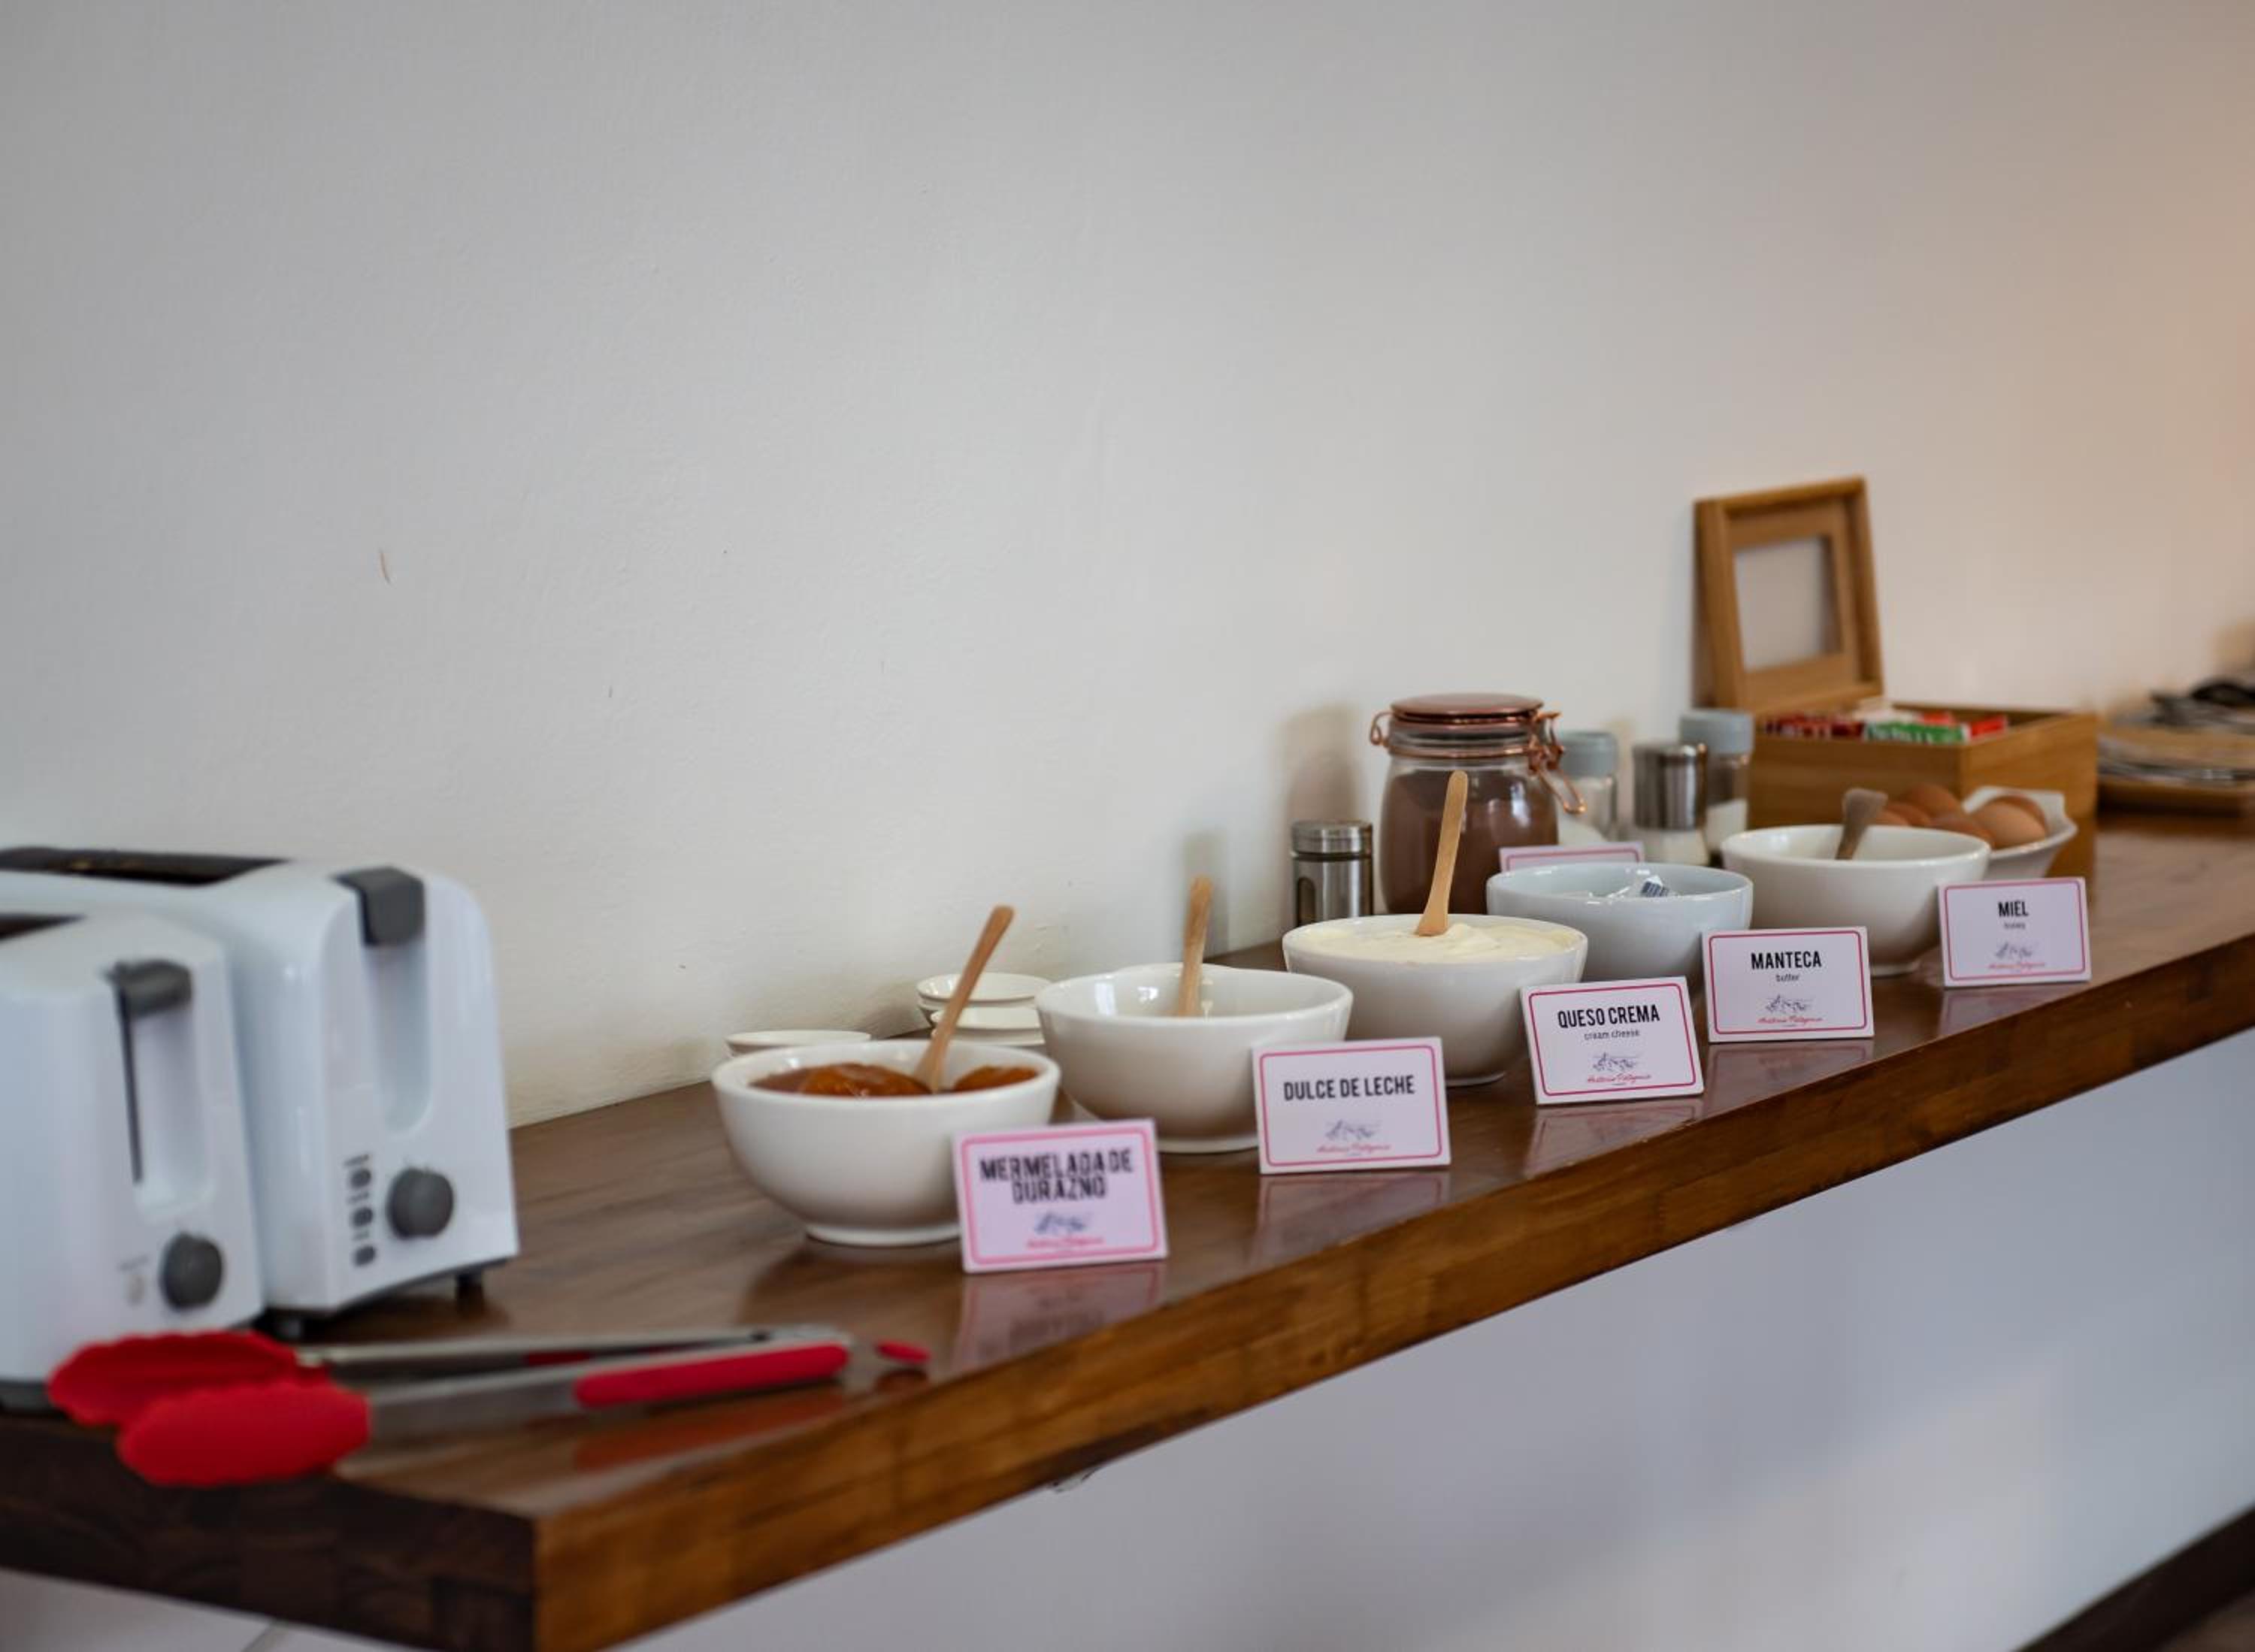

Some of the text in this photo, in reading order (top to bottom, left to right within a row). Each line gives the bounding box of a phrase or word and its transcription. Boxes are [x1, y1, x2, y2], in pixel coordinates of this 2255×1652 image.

[1998, 901, 2029, 918] MIEL
[1751, 951, 1822, 970] MANTECA
[1557, 1004, 1660, 1029] QUESO CREMA
[1584, 1028, 1640, 1041] cream cheese
[1283, 1075, 1415, 1101] DULCE DE LECHE
[979, 1148, 1134, 1182] MERMELADA DE
[1012, 1176, 1107, 1204] DURAZNO
